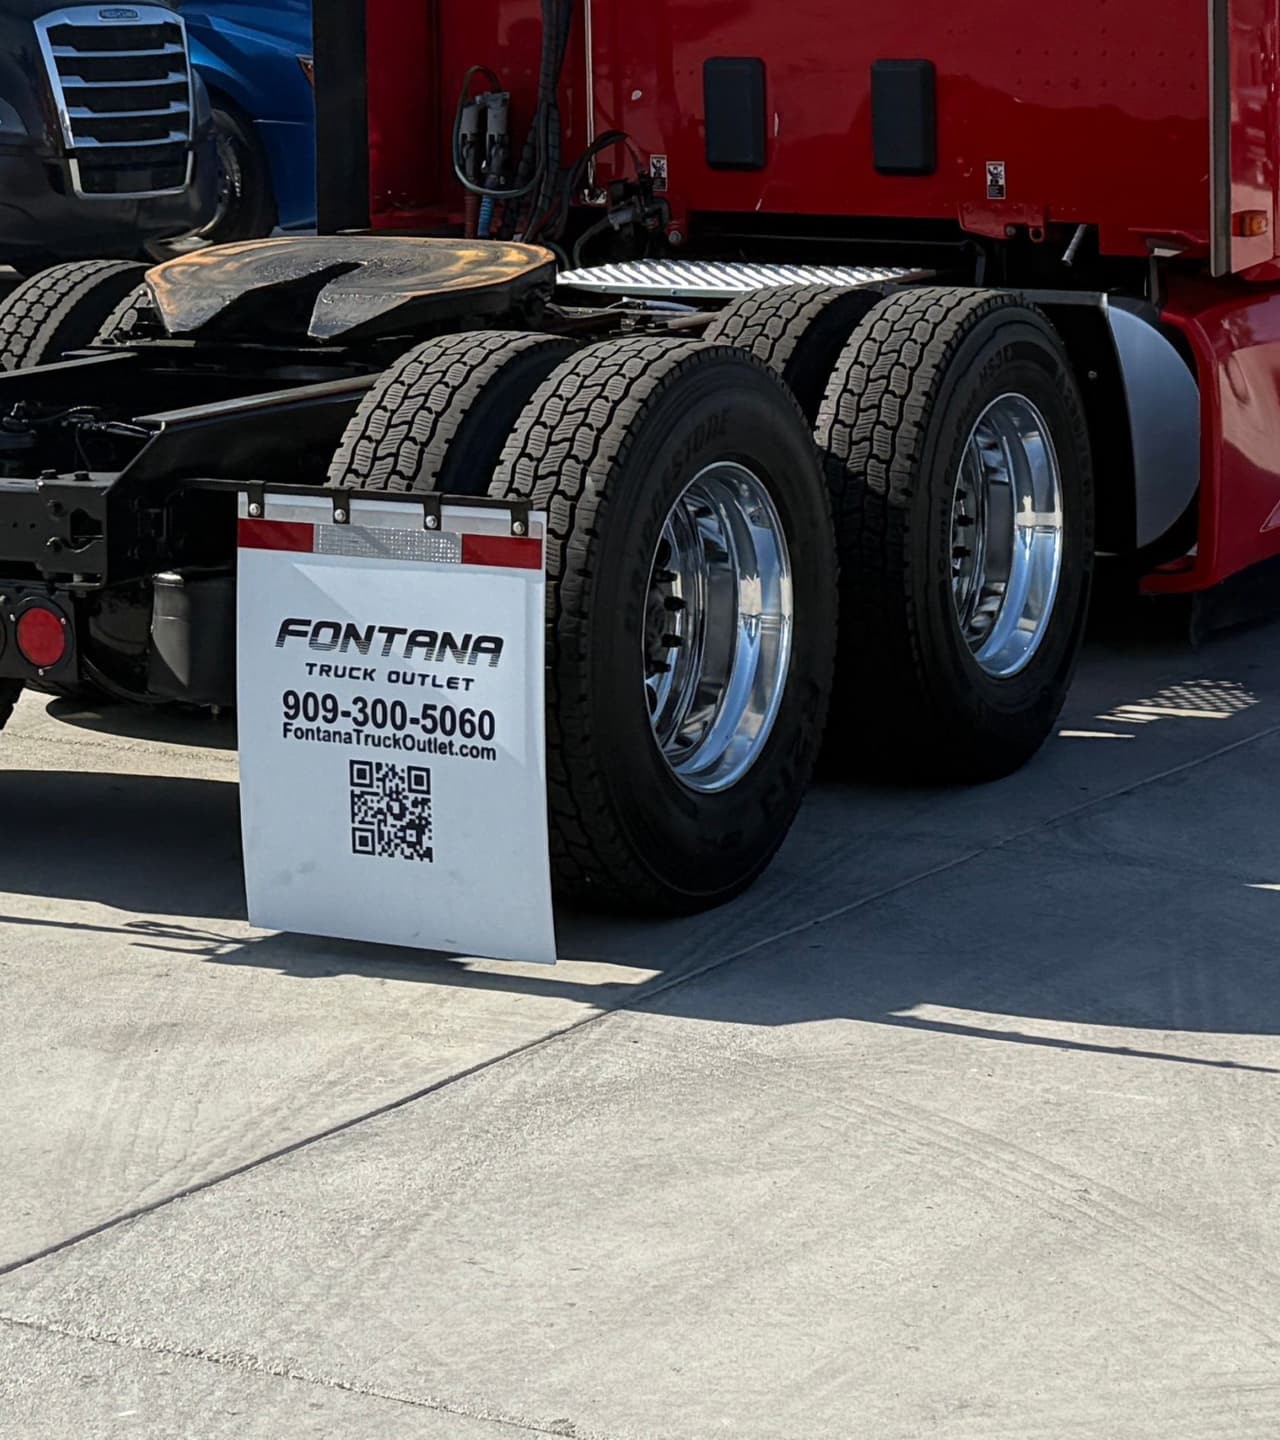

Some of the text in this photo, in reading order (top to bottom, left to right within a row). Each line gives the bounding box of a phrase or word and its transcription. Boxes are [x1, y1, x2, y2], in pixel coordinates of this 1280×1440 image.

[274, 617, 505, 667] FONTANA
[305, 662, 475, 691] TRUCK OUTLET
[282, 690, 496, 741] 909-300-5060
[282, 722, 497, 761] FontanaTruckOutlet.com
